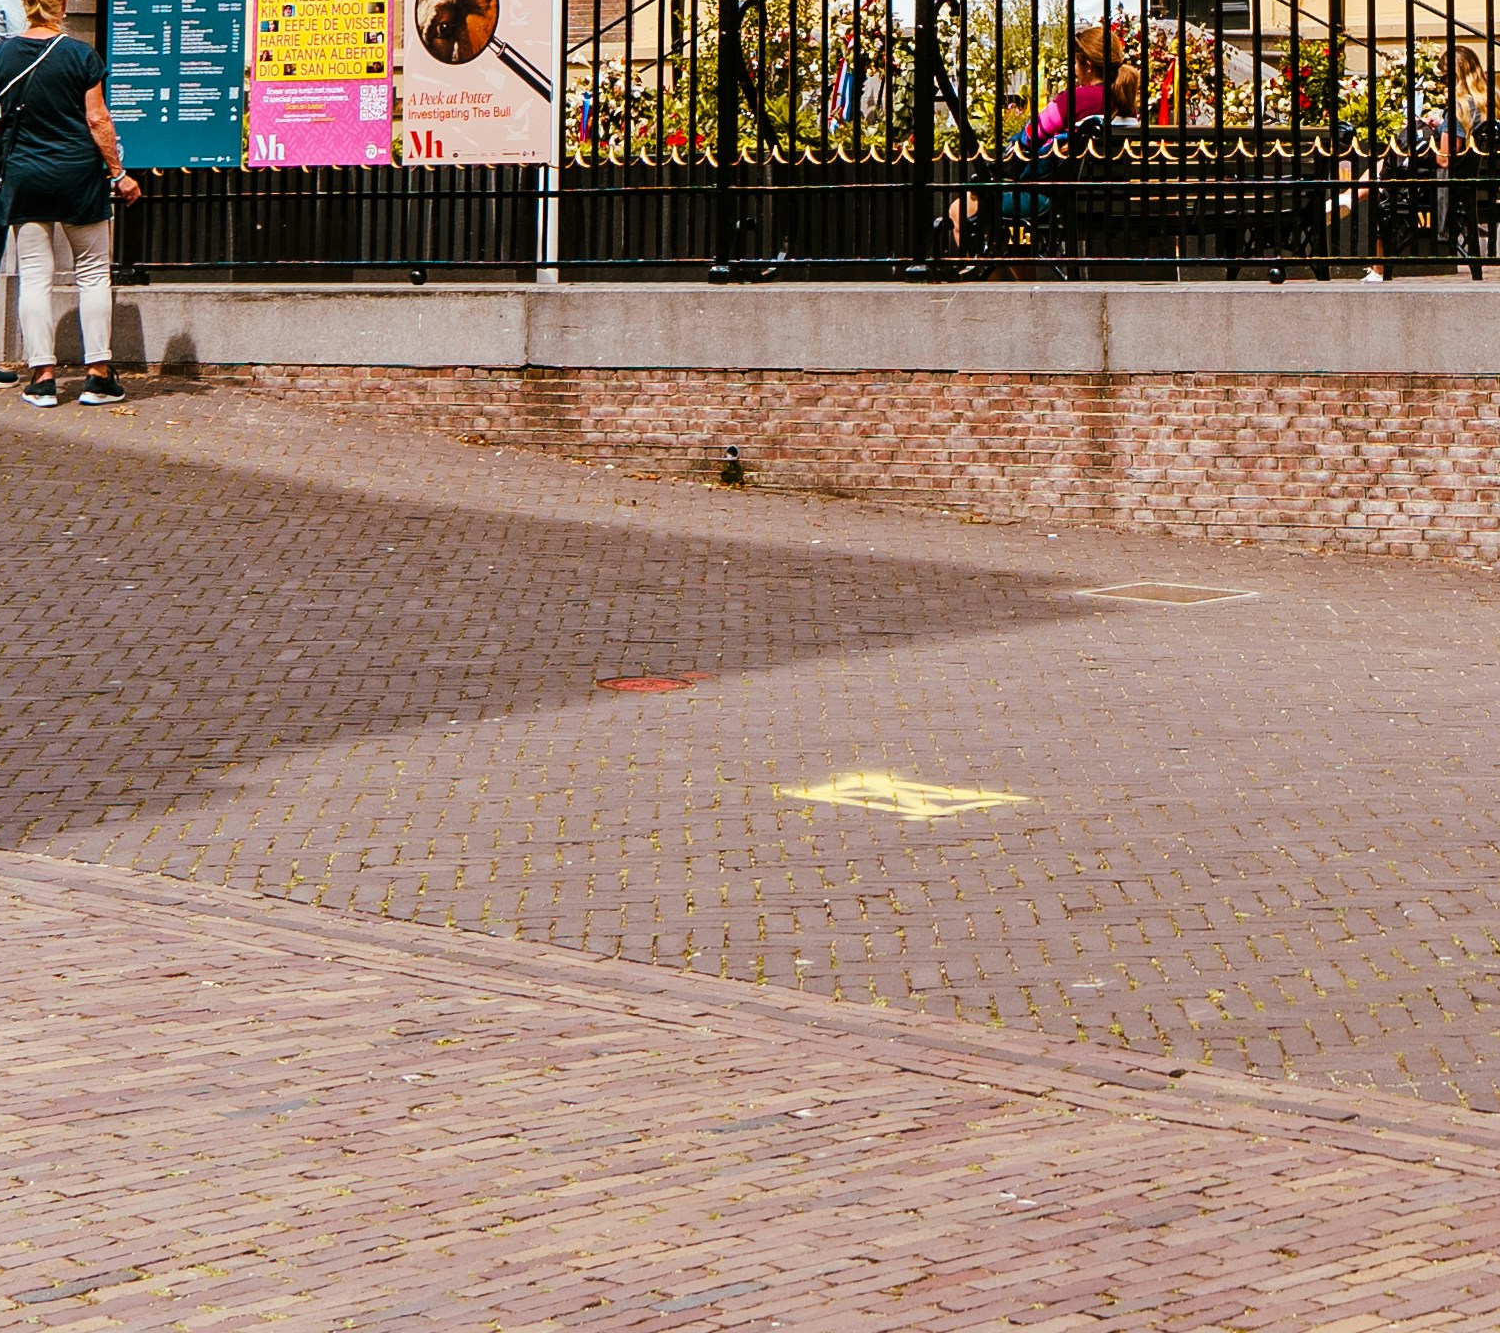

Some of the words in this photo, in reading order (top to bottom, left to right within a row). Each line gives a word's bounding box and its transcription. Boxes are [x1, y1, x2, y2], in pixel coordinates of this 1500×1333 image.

[261, 6, 278, 18] KIK
[299, 4, 328, 17] JOYA
[332, 3, 364, 15] MOOI
[285, 19, 318, 31] EEFJE
[324, 18, 338, 30] DE
[344, 17, 385, 29] VISSER
[260, 34, 300, 47] HARRIE
[307, 33, 358, 46] JEKKERS
[277, 48, 327, 62] LATANYA
[330, 47, 384, 59] ALBERTO
[260, 65, 279, 77] DIO
[301, 63, 323, 75] SAN
[328, 62, 362, 74] HOLO
[408, 93, 417, 106] A
[420, 91, 444, 106] Peek
[446, 92, 458, 104] at
[460, 91, 493, 104] Potter
[408, 108, 469, 121] Investigating
[472, 107, 491, 118] The
[493, 106, 511, 117] Bull
[253, 134, 285, 161] Mh
[408, 130, 444, 159] Mh
